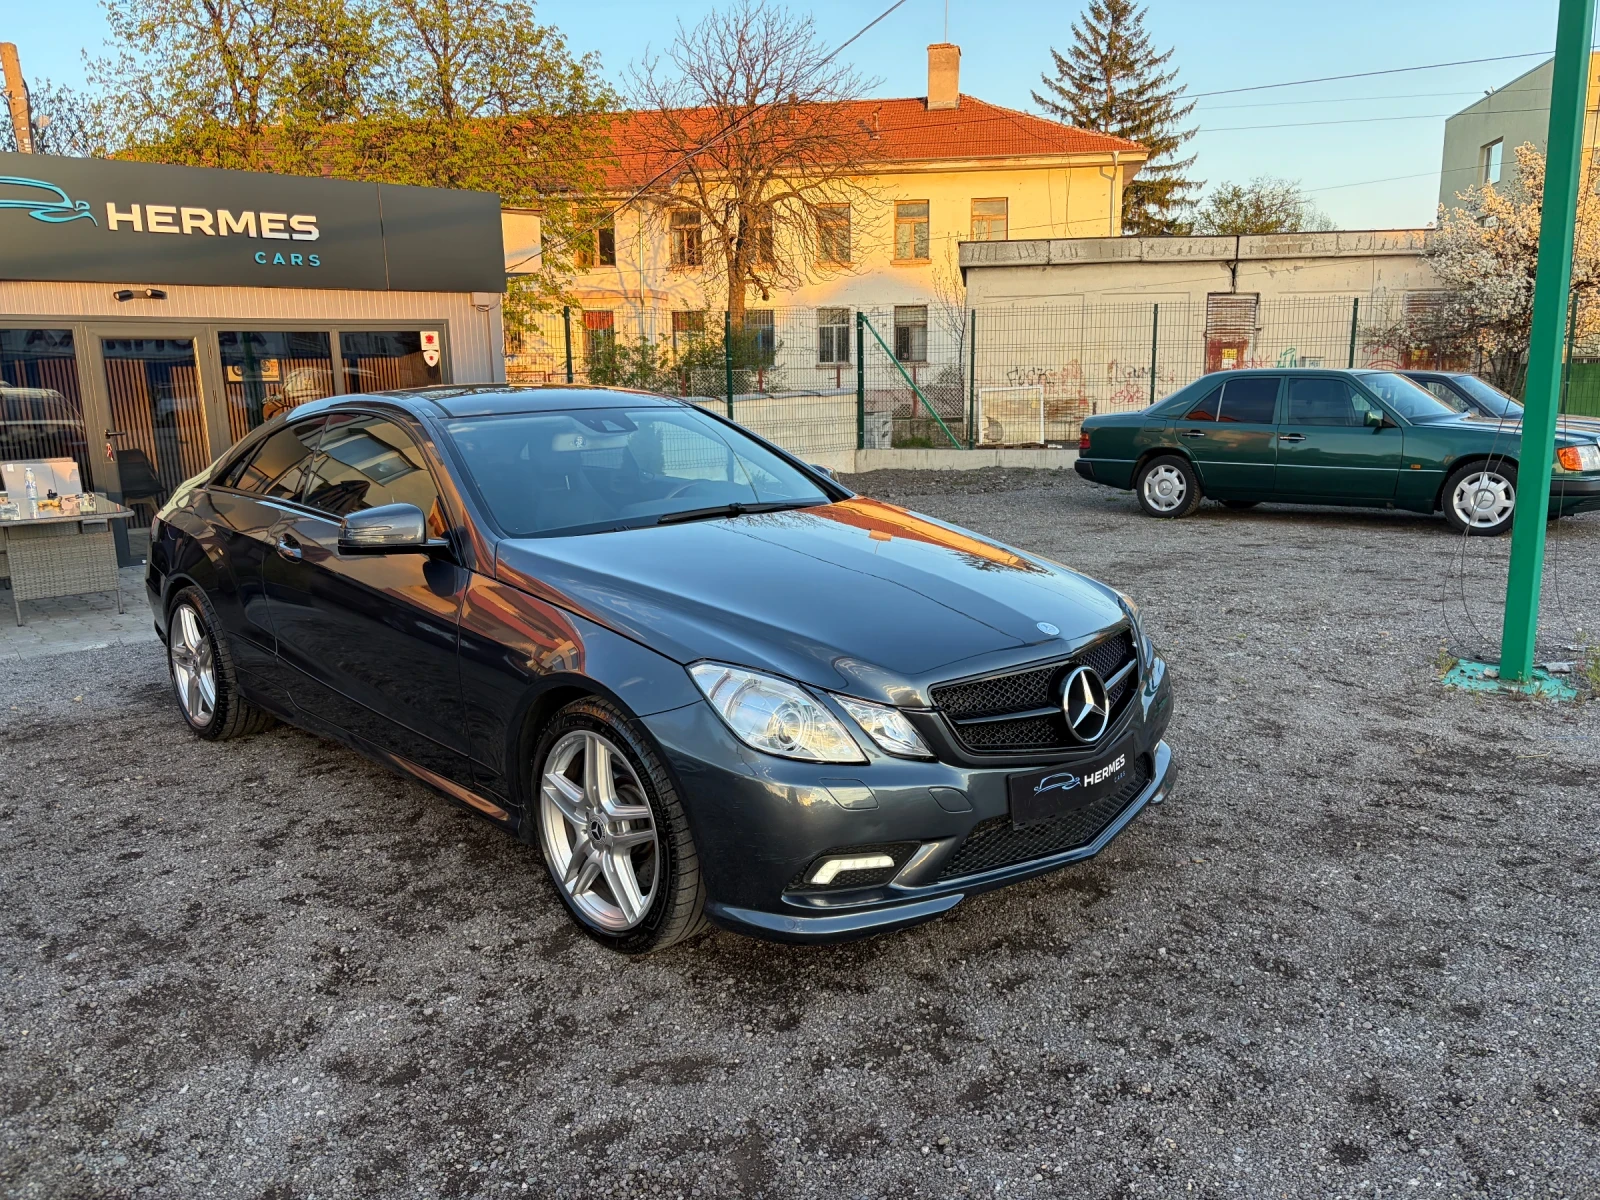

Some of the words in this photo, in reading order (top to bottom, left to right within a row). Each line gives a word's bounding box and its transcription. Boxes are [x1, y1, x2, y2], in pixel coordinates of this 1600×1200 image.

[106, 202, 320, 241] HERMES
[254, 251, 321, 267] CARS
[1084, 753, 1125, 787] HERMES
[1114, 771, 1126, 783] CARS
